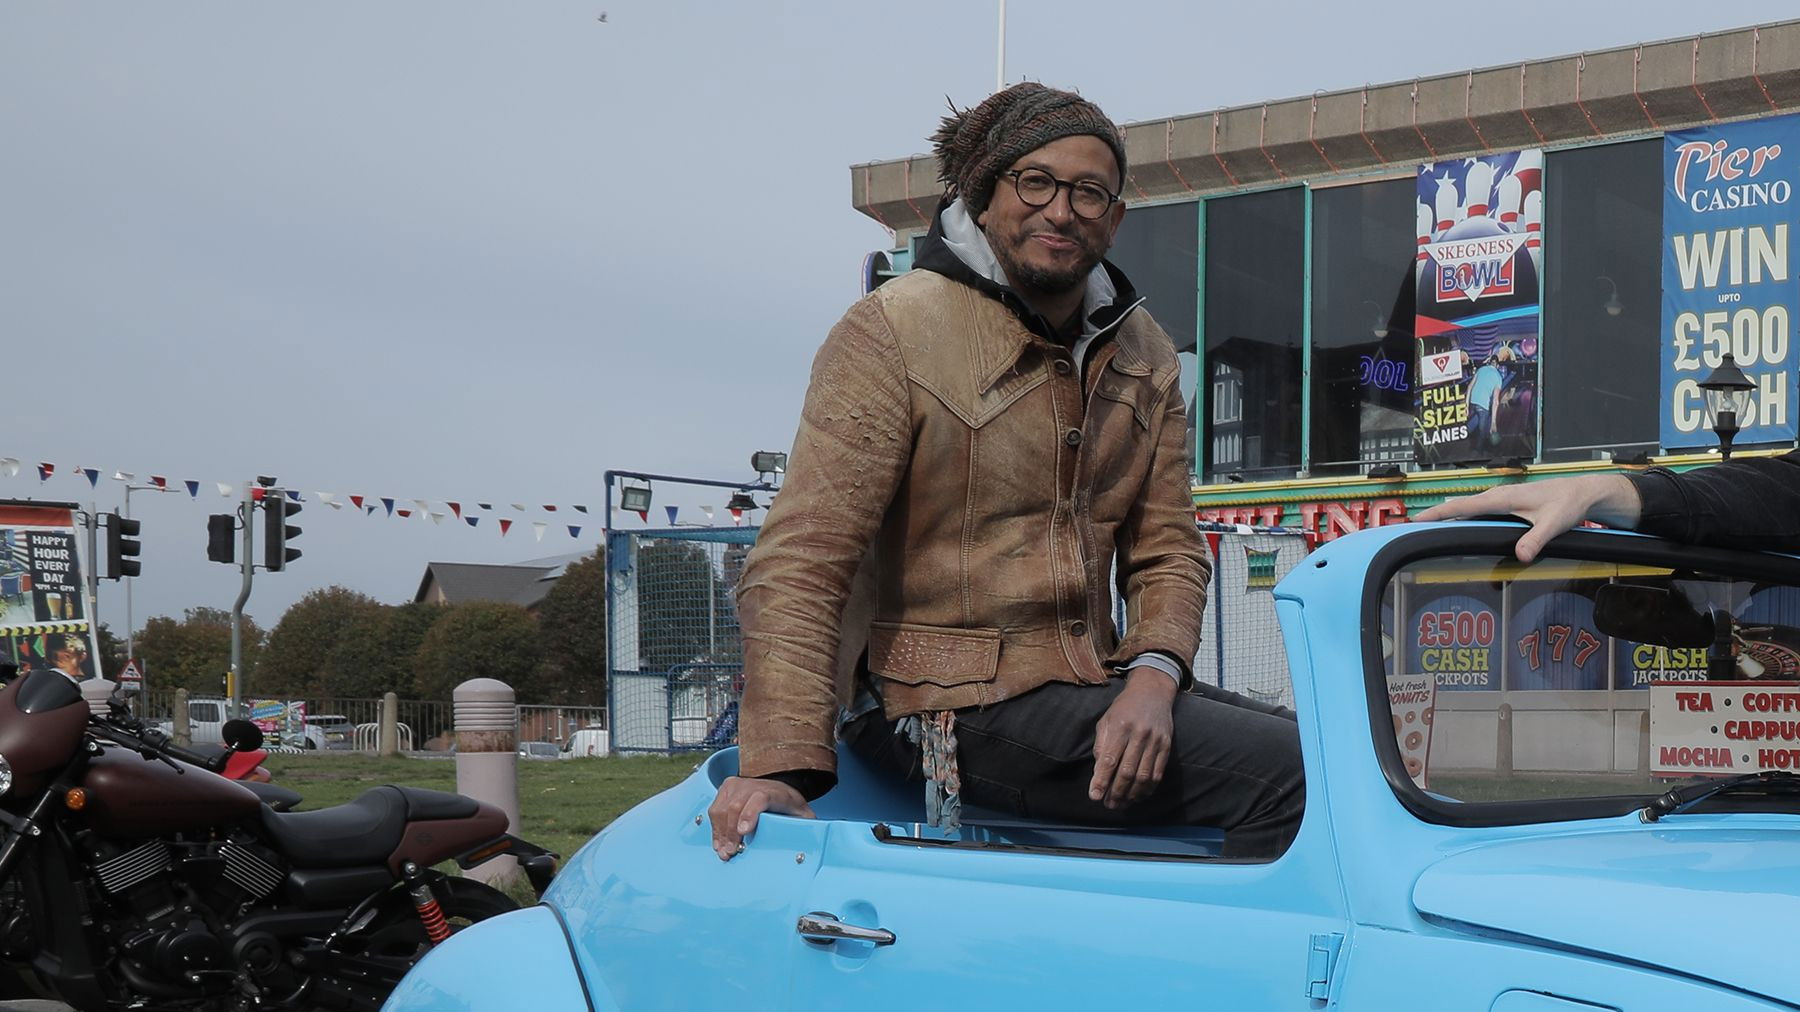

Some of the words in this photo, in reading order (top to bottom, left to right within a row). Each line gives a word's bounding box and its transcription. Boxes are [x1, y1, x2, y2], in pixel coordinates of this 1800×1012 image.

[1674, 139, 1782, 203] Pier
[1691, 180, 1792, 213] CASINO
[1437, 238, 1514, 261] SKEGNESS
[1673, 223, 1788, 290] WIN
[1440, 259, 1510, 292] BOWL
[1718, 292, 1741, 304] UPTO
[1673, 305, 1789, 371] £500
[1422, 384, 1466, 407] FULL
[1423, 403, 1468, 429] SIZE
[1423, 425, 1469, 446] LANES
[32, 535, 68, 547] HAPPY
[33, 547, 69, 560] HOUR
[35, 560, 70, 572] EVERY
[43, 572, 65, 584] DAY
[1418, 611, 1495, 647] £500
[1421, 648, 1490, 672] CASH
[1632, 645, 1708, 669] CASH
[1389, 681, 1405, 692] Hot
[1433, 672, 1489, 686] CKPOTS
[1632, 670, 1708, 686] JACKPOTS
[1675, 692, 1714, 713] TEA
[1659, 746, 1733, 768] MOCHA
